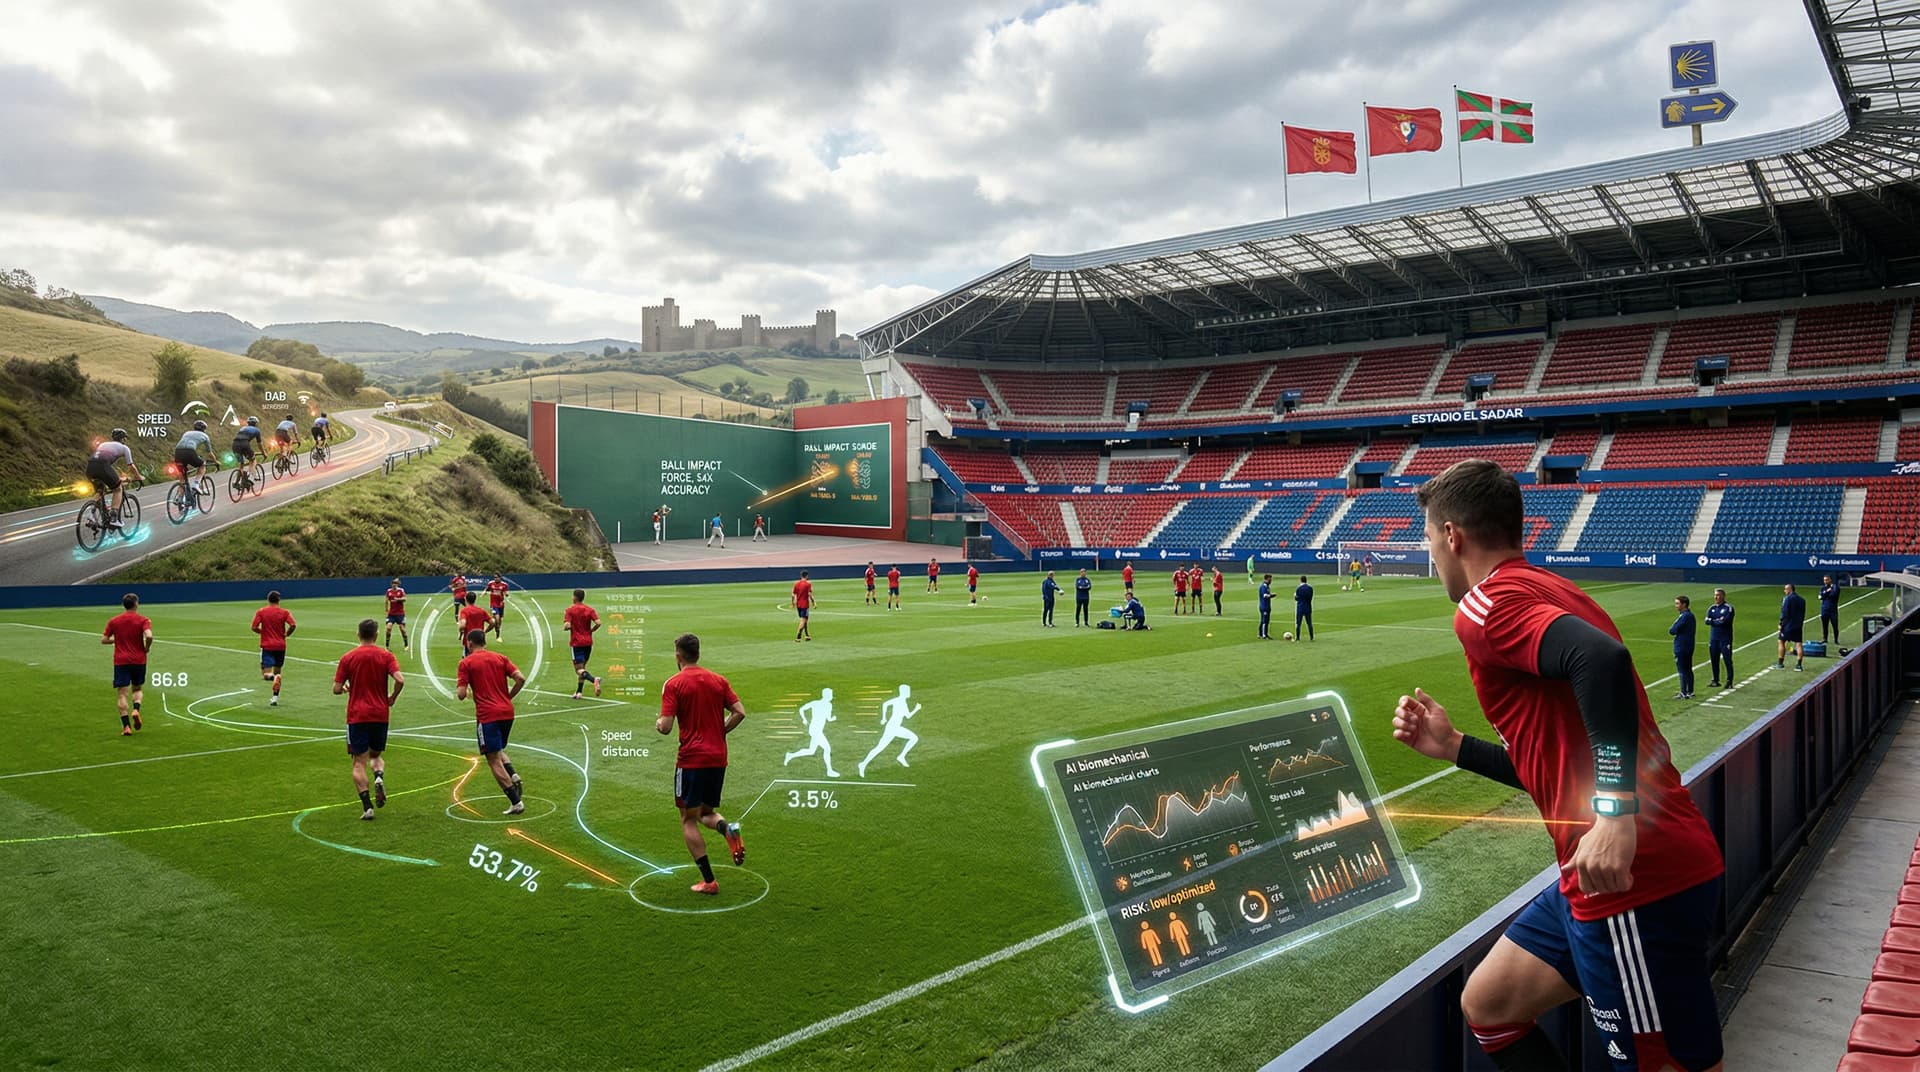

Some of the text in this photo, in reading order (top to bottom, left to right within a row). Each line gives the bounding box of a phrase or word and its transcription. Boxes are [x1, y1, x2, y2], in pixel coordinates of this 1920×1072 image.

[1411, 408, 1524, 424] ESTADIO EL SADAR
[823, 443, 850, 452] IMPACT
[661, 460, 722, 471] BALL IMPACT
[661, 472, 694, 484] FORCE,
[660, 484, 711, 496] ACCURACY
[1066, 746, 1150, 775] AI biomechanical
[1073, 783, 1083, 793] AI
[1136, 767, 1160, 780] charts
[1120, 879, 1217, 920] RISK: low/optimized
